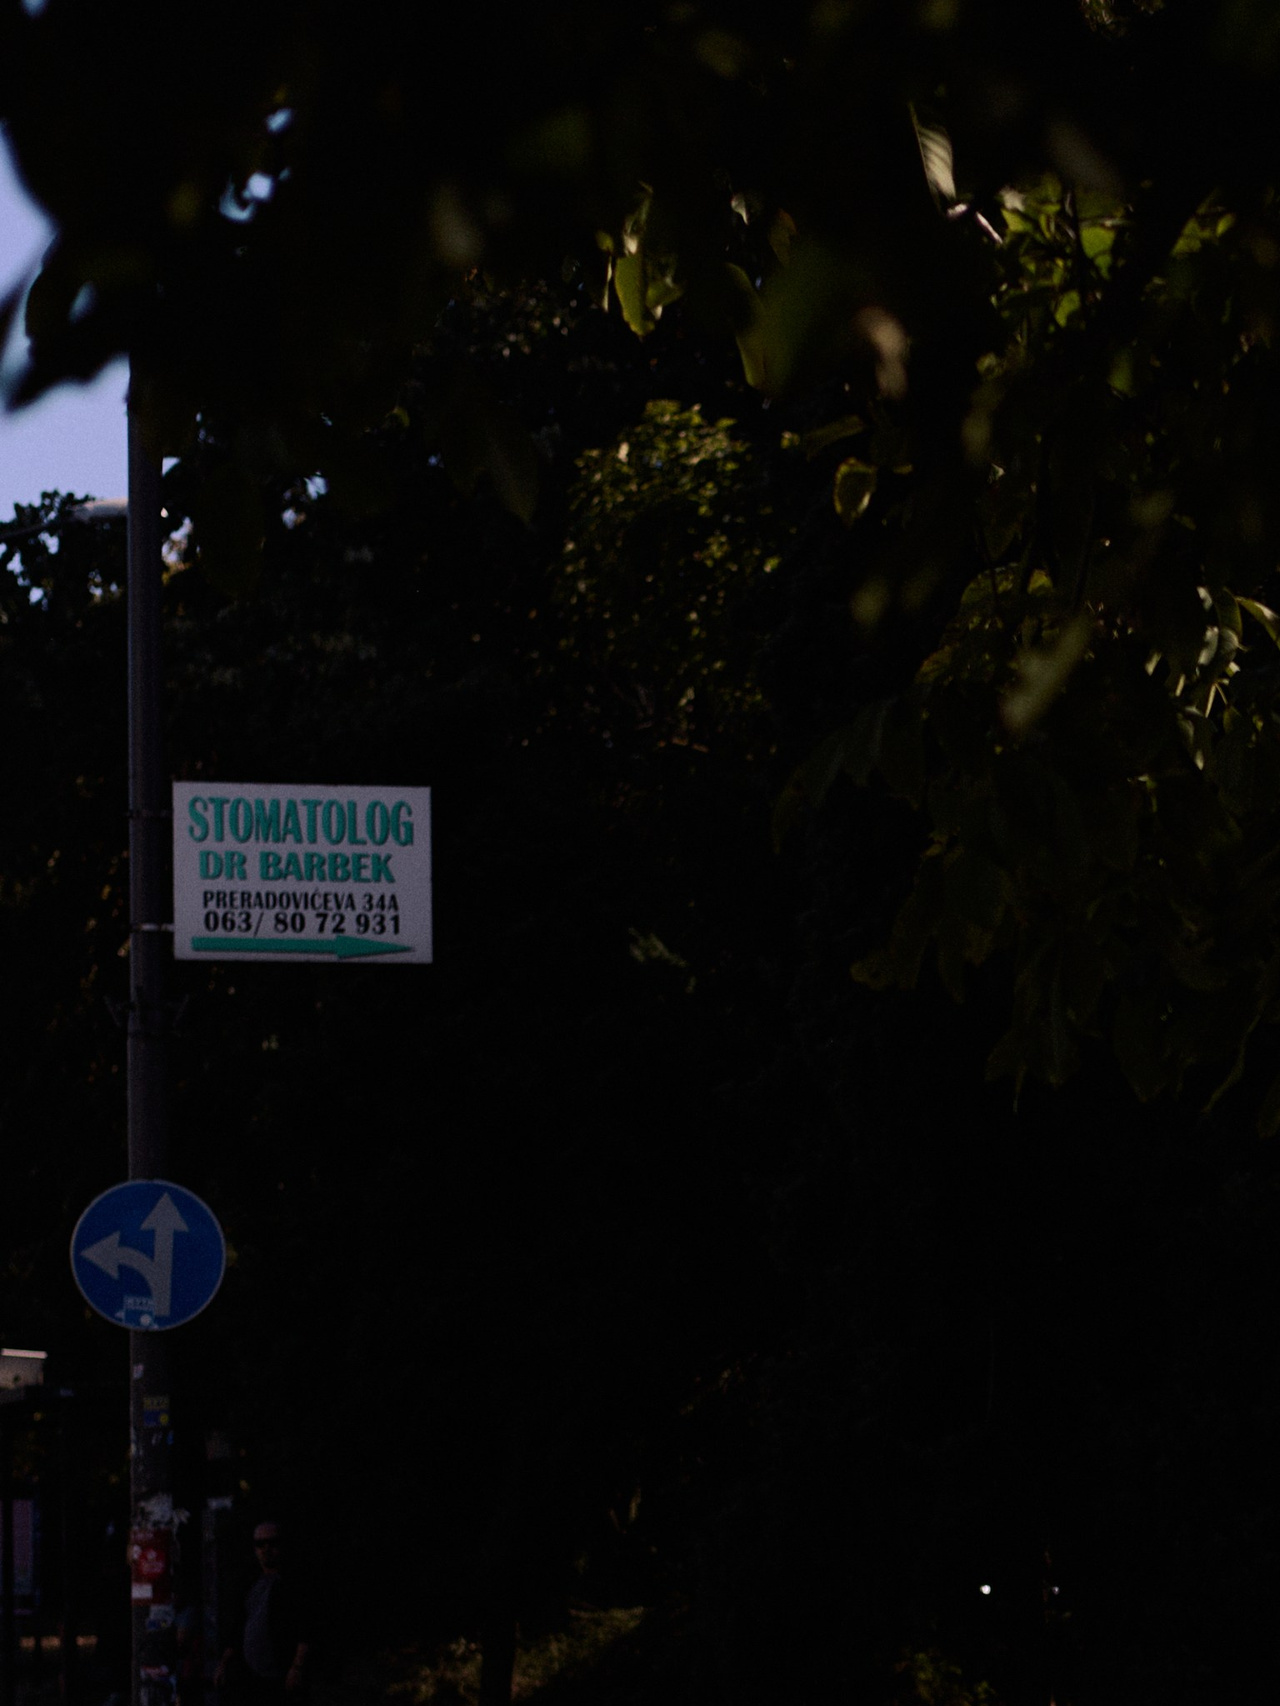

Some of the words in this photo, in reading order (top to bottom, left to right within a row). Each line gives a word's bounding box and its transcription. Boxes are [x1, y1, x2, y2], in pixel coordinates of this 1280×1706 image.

[189, 796, 414, 846] STOMATOLOG
[200, 850, 247, 880] DR
[260, 851, 395, 883] BARBEK
[203, 888, 356, 912] PRERADOVIĆEVA
[363, 893, 399, 912] 34A
[205, 911, 264, 937] 063/
[274, 912, 305, 933] 80
[316, 913, 345, 934] 72
[356, 913, 400, 935] 931
